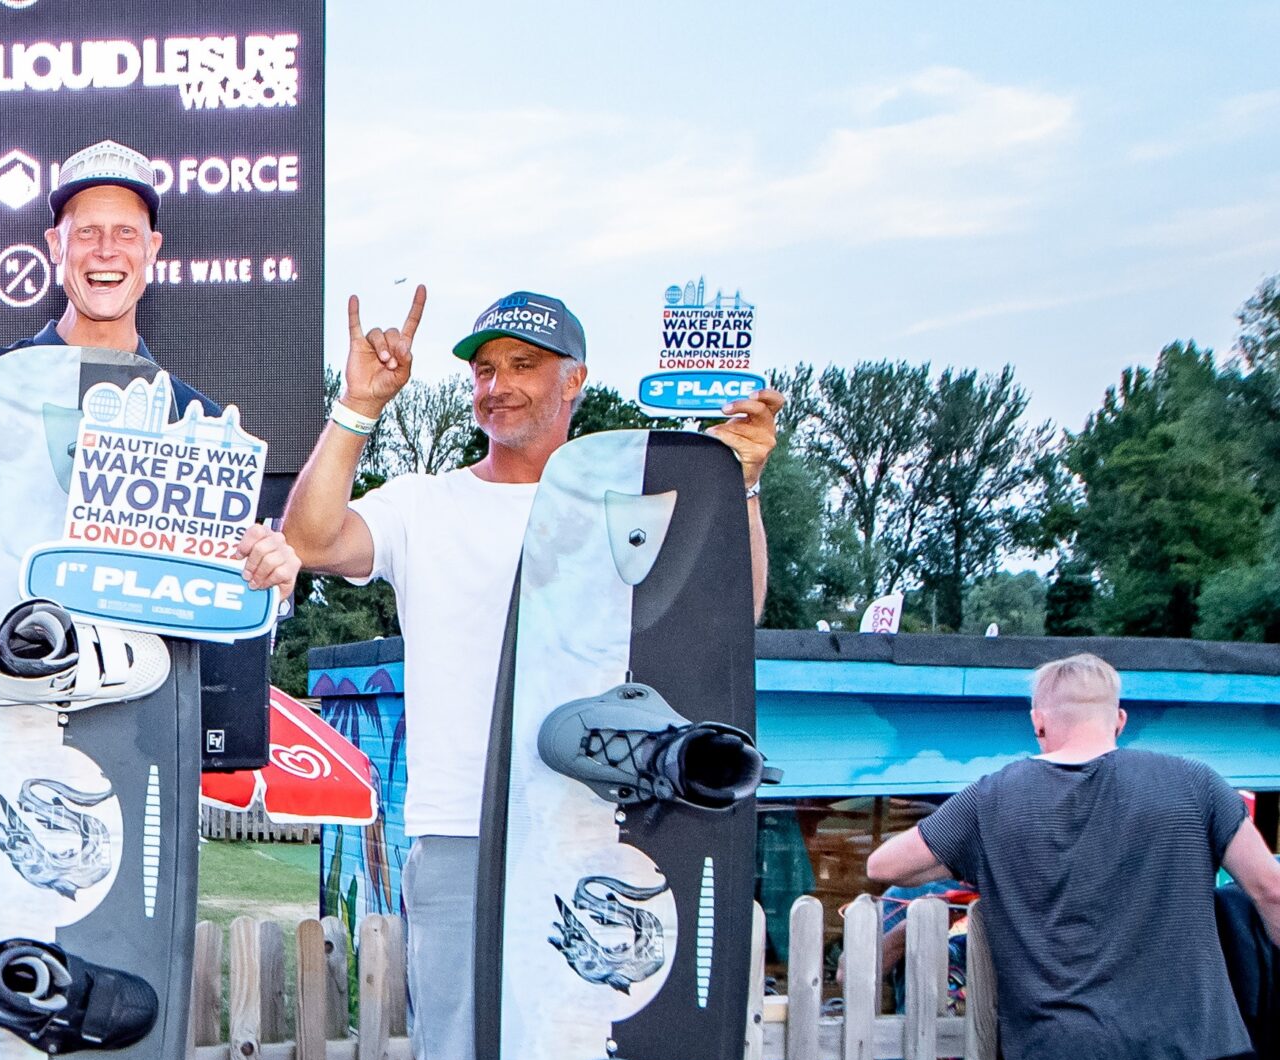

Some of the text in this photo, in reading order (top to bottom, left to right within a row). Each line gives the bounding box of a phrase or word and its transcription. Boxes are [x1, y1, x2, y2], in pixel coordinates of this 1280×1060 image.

[179, 156, 298, 194] FORCE
[190, 258, 252, 284] WAKE
[663, 319, 753, 330] WAKE PARK
[671, 310, 754, 319] NAUTIQUE WWA
[660, 350, 751, 358] CHAMPIONSHIPS
[662, 331, 752, 349] WORLD
[659, 359, 750, 369] LONDON 2022
[677, 380, 757, 396] PLACE
[98, 434, 259, 469] NAUTIQUE WWA
[82, 448, 257, 491] WAKE PARK
[78, 471, 252, 522] WORLD
[69, 521, 176, 552] LONDON
[72, 505, 247, 541] CHAMPIONSHIPS
[56, 560, 88, 587] 1ST
[92, 566, 246, 611] PLACE
